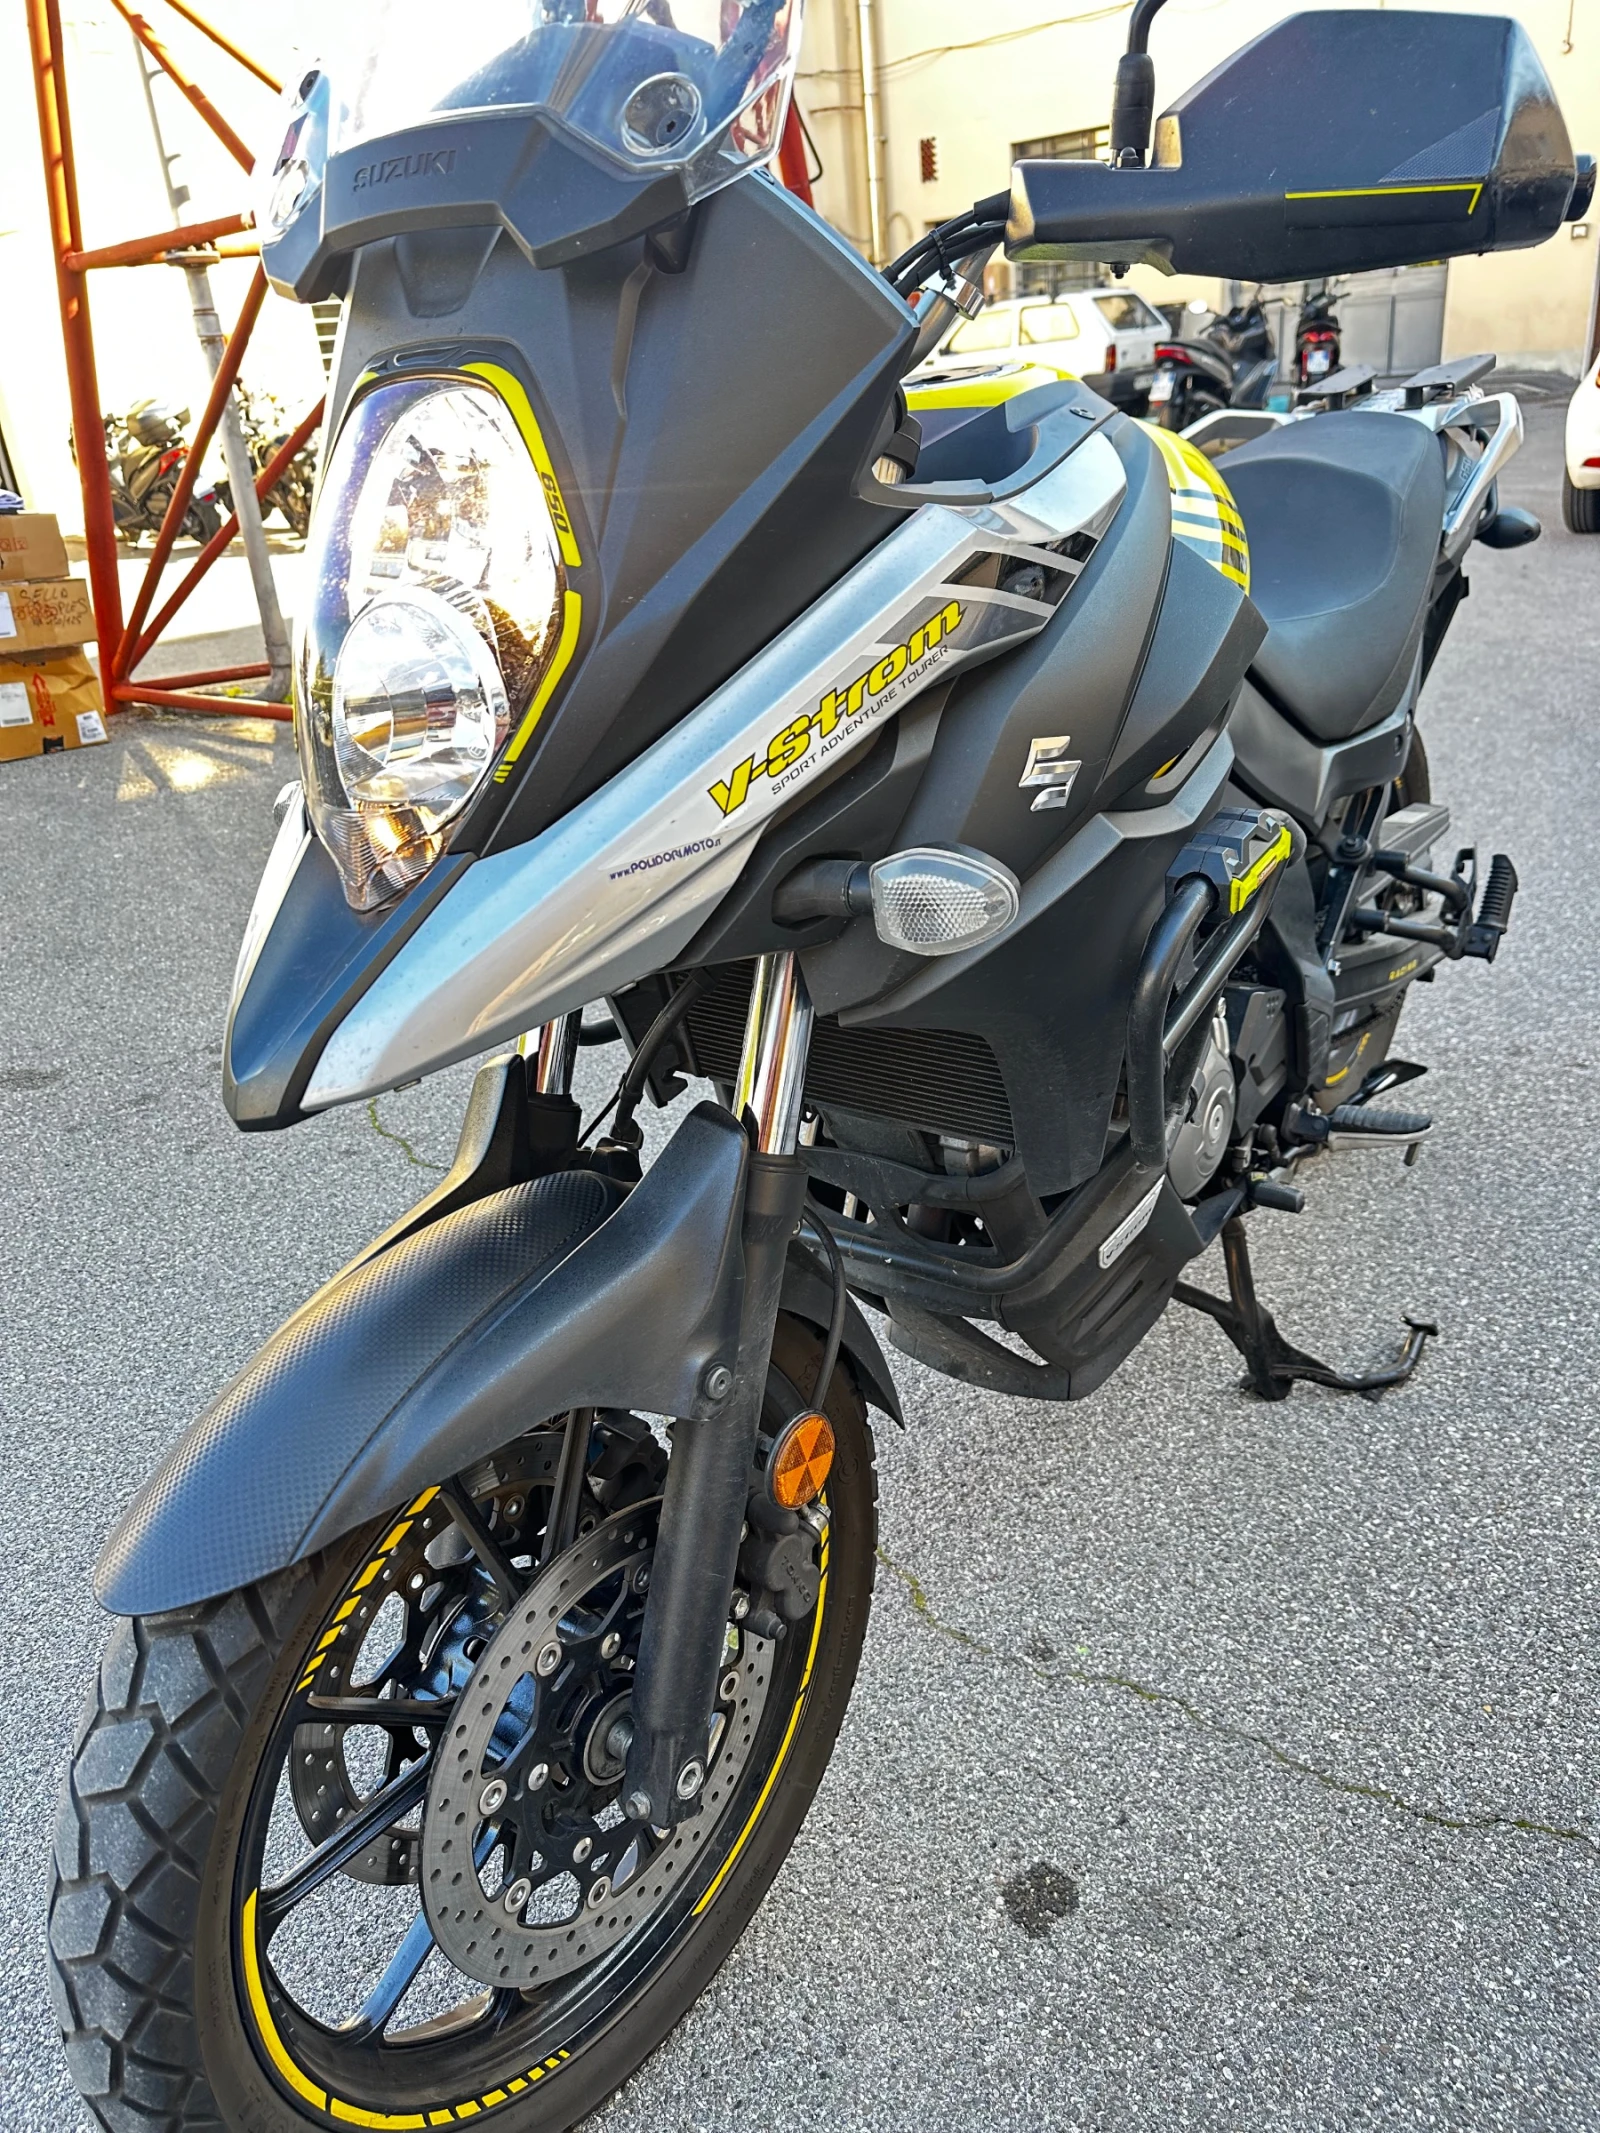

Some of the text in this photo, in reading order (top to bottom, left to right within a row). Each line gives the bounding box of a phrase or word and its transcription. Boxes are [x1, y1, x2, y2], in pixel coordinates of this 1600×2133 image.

[353, 150, 457, 192] SUZUKI
[541, 471, 570, 534] 650
[707, 599, 968, 818] V-Strom
[771, 644, 949, 795] SPORT ADVENTURE TOURER
